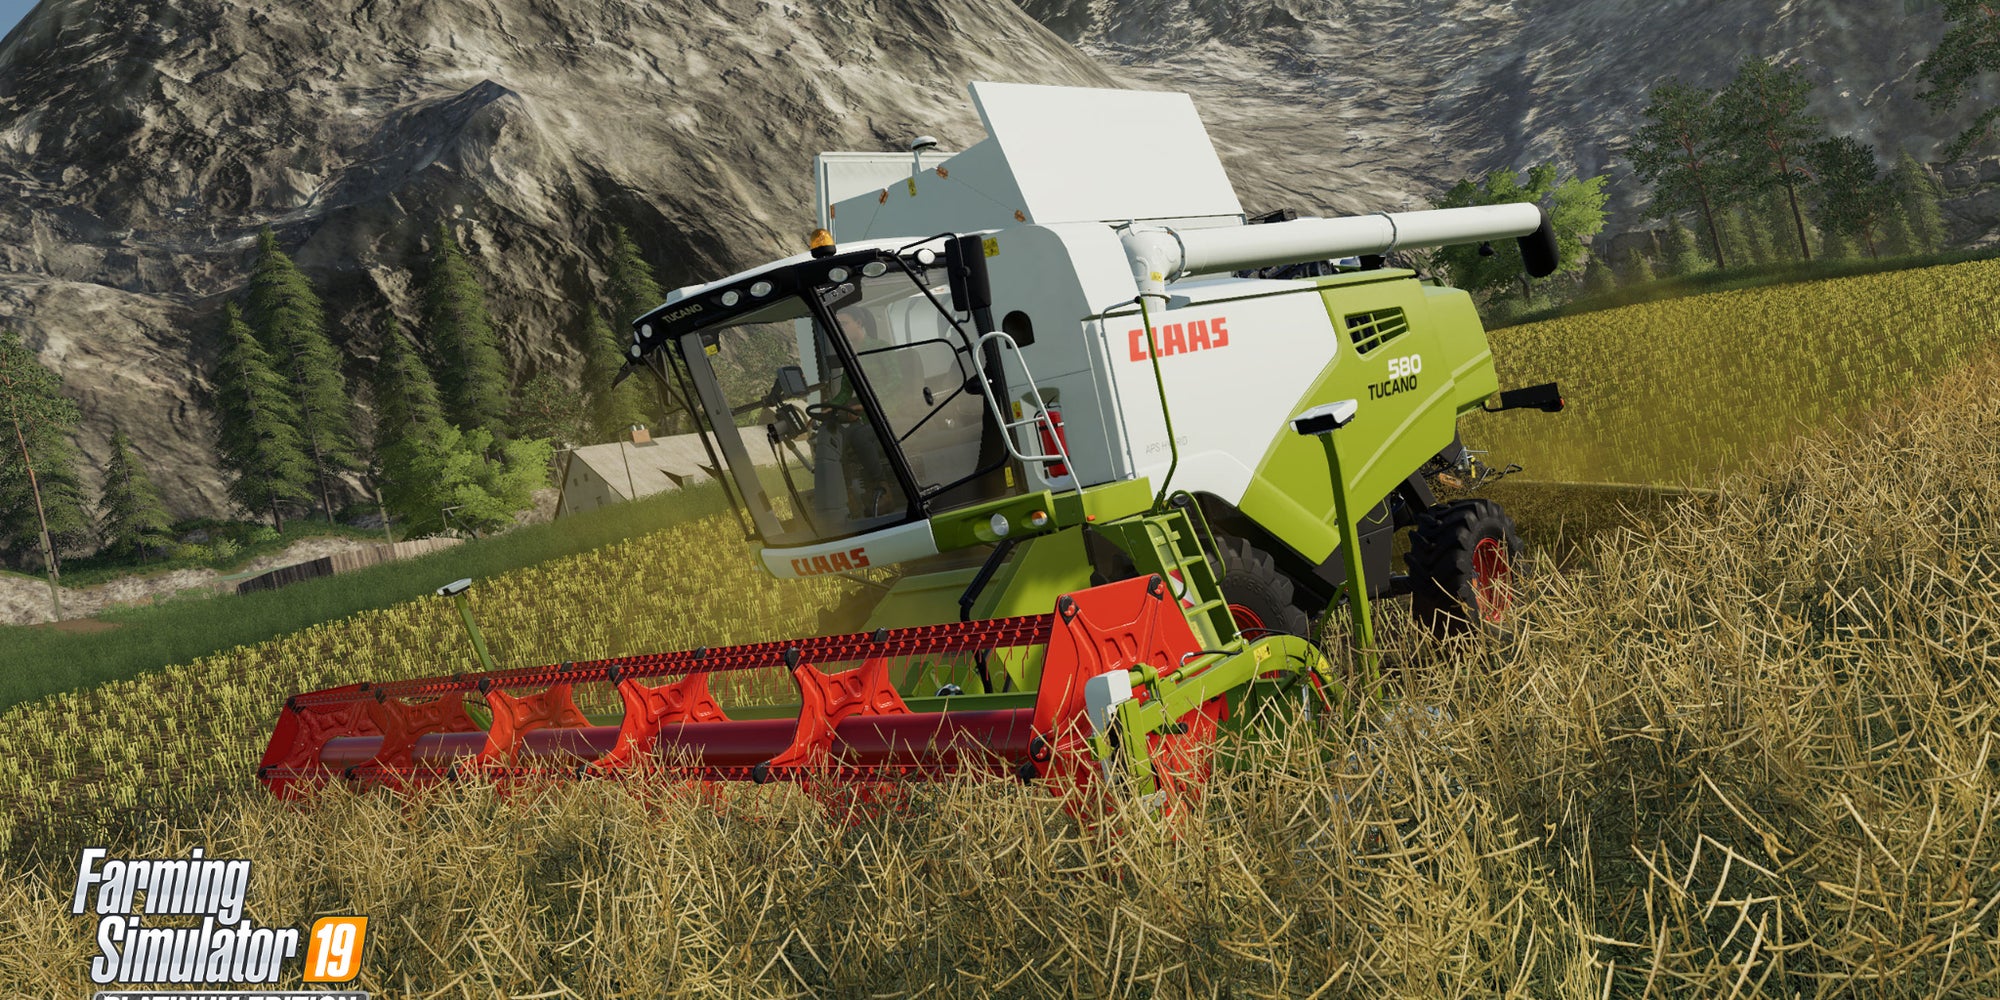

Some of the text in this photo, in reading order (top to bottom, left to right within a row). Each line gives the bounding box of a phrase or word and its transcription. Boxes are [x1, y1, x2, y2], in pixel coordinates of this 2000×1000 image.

[662, 303, 704, 324] TUCANO
[1128, 317, 1229, 363] CLAAS
[1388, 353, 1422, 380] 580
[1367, 375, 1418, 401] TUCANO
[790, 547, 871, 577] CLAAS
